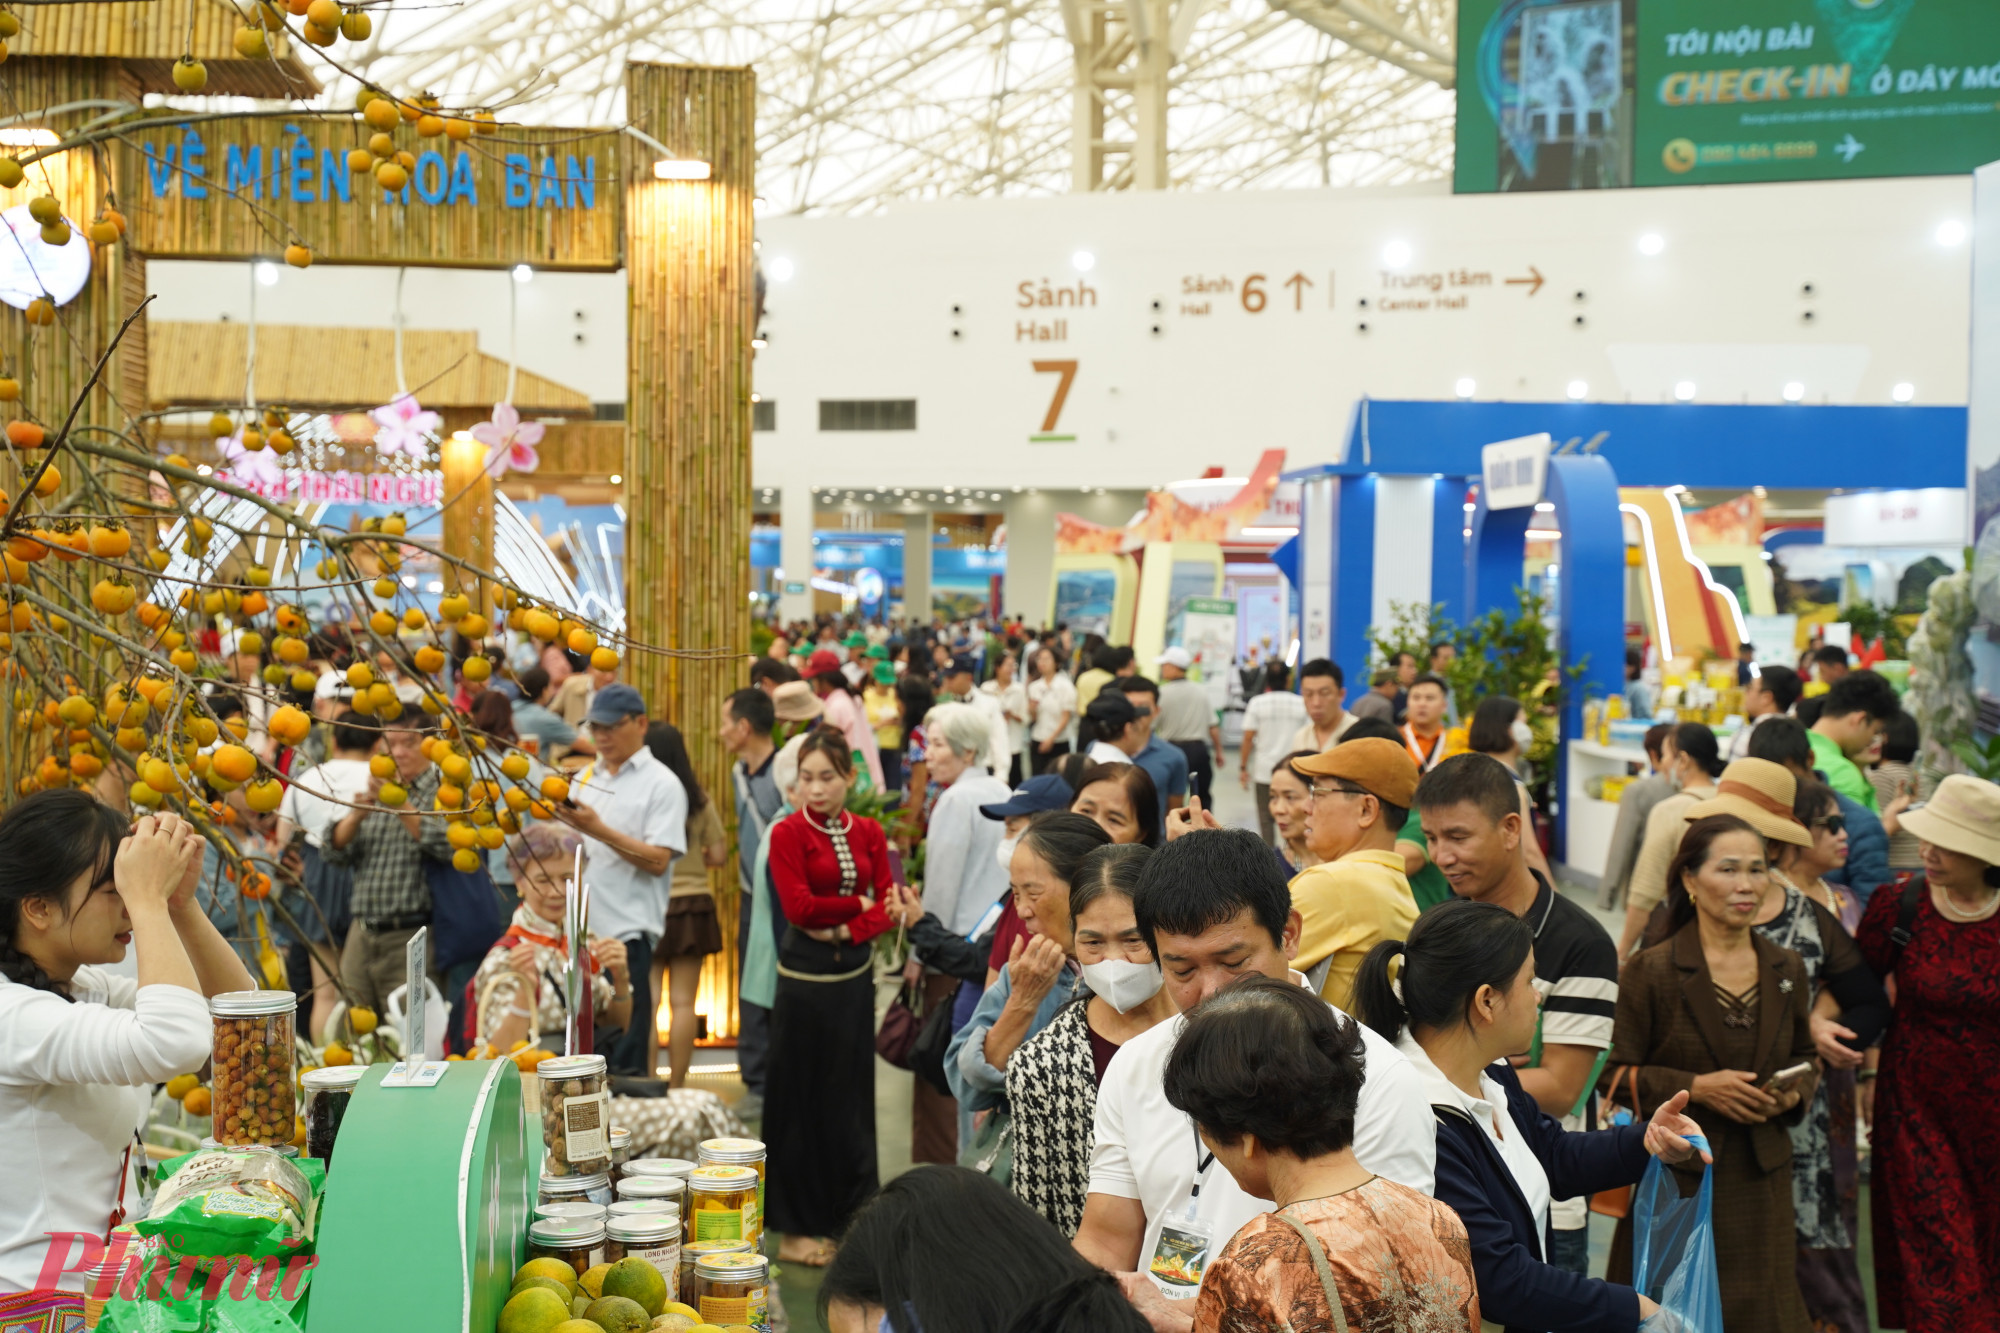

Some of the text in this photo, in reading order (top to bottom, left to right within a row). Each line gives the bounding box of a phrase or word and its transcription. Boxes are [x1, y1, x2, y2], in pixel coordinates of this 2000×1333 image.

[1665, 21, 1814, 57] TỚI NỘI BÀI
[1661, 63, 1852, 105] CHECK-IN
[144, 122, 207, 198] VỀ
[228, 123, 350, 202] MIỀN
[505, 153, 595, 208] BAN
[1017, 277, 1096, 309] Sảnh
[1241, 274, 1267, 313] 6
[1379, 268, 1492, 292] Trung tâm
[1180, 302, 1211, 316] Hall
[1379, 295, 1468, 312] Center Hall
[1015, 319, 1067, 342] Hall
[1031, 359, 1078, 432] 7
[644, 1250, 661, 1259] LONG
